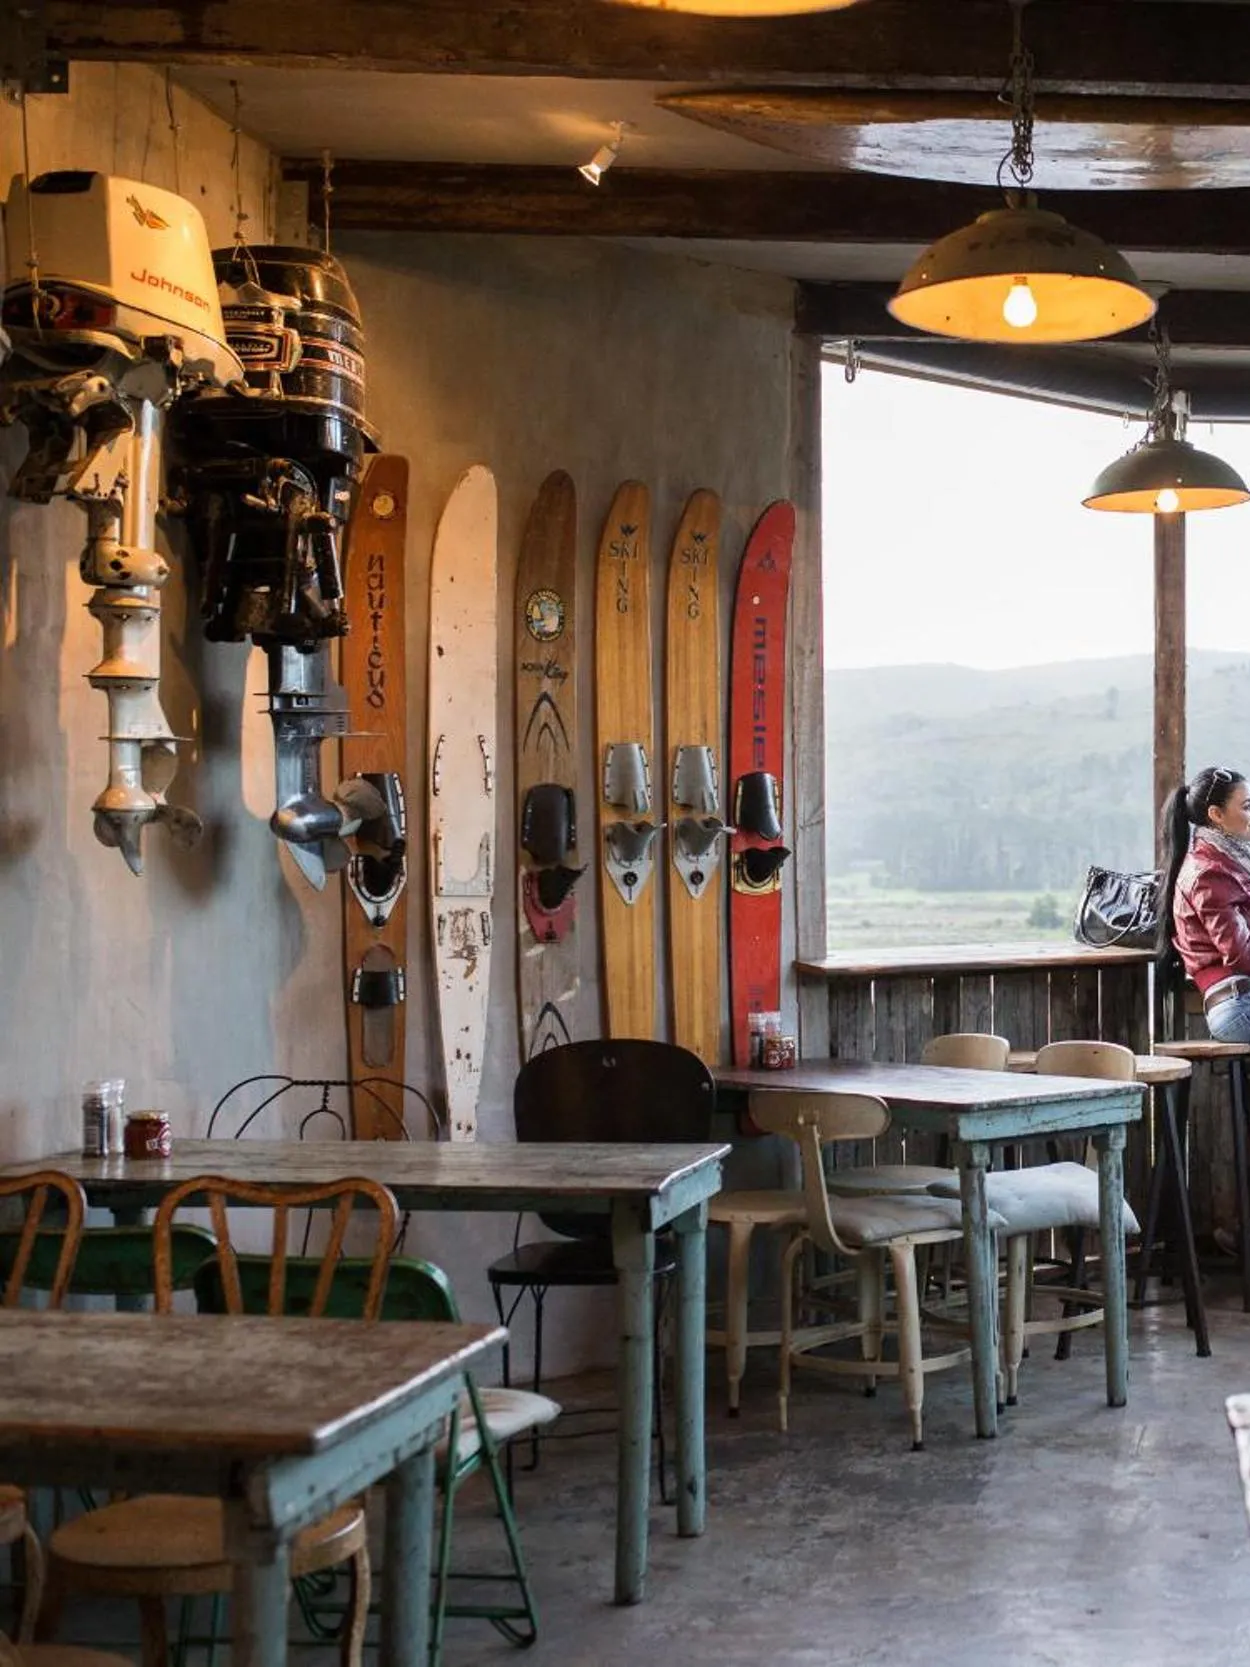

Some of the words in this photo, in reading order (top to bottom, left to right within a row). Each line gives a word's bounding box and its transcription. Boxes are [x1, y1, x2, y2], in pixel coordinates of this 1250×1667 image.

[130, 268, 211, 313] Johnson
[608, 541, 639, 559] SKI
[681, 548, 709, 566] SKI
